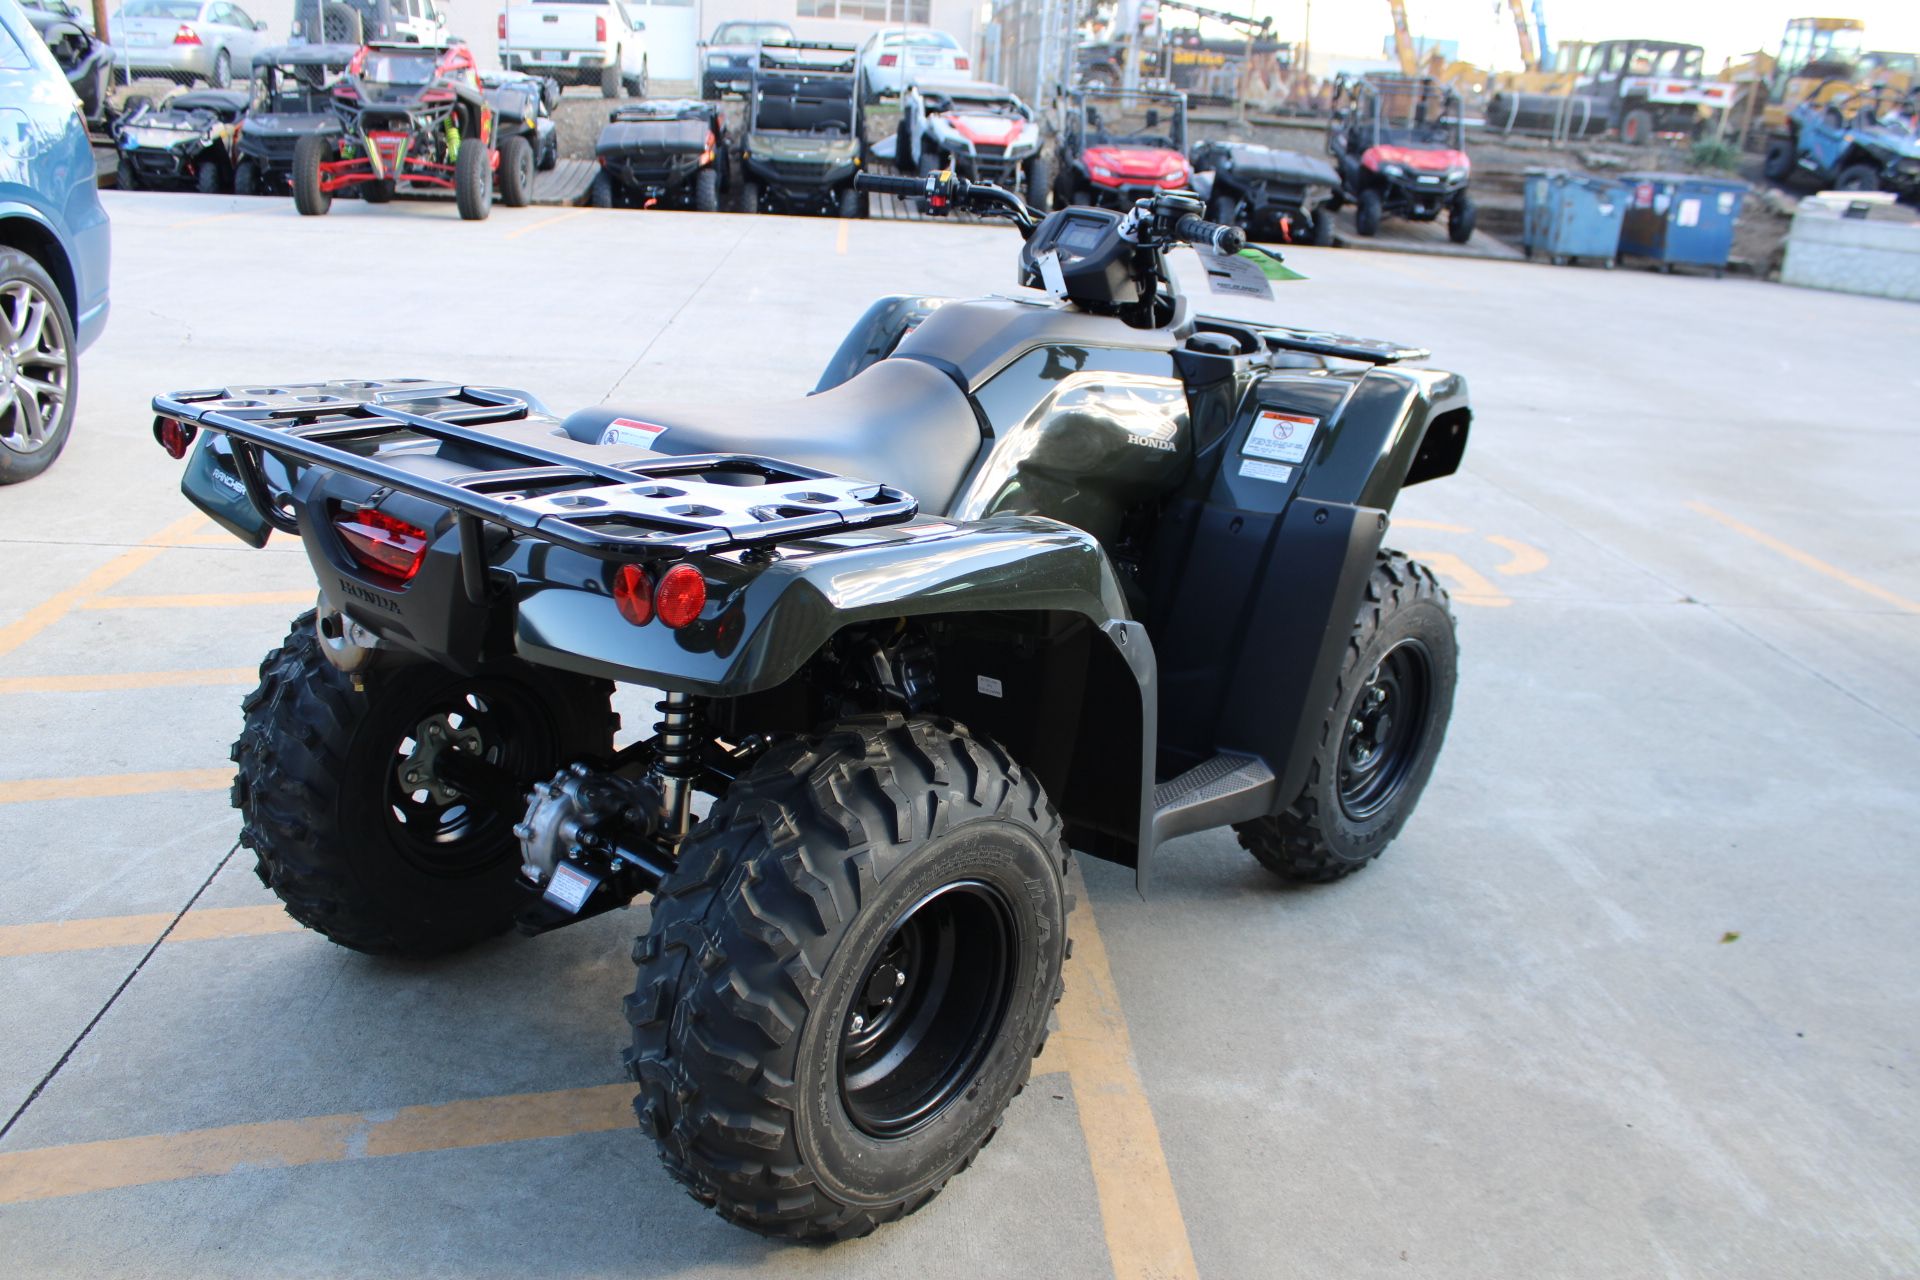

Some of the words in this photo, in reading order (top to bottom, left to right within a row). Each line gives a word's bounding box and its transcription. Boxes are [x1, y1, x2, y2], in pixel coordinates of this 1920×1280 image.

[1127, 433, 1177, 452] HONDA
[212, 468, 247, 496] RANCHER
[339, 578, 403, 615] HONDA
[1007, 878, 1051, 1070] MAXXI
